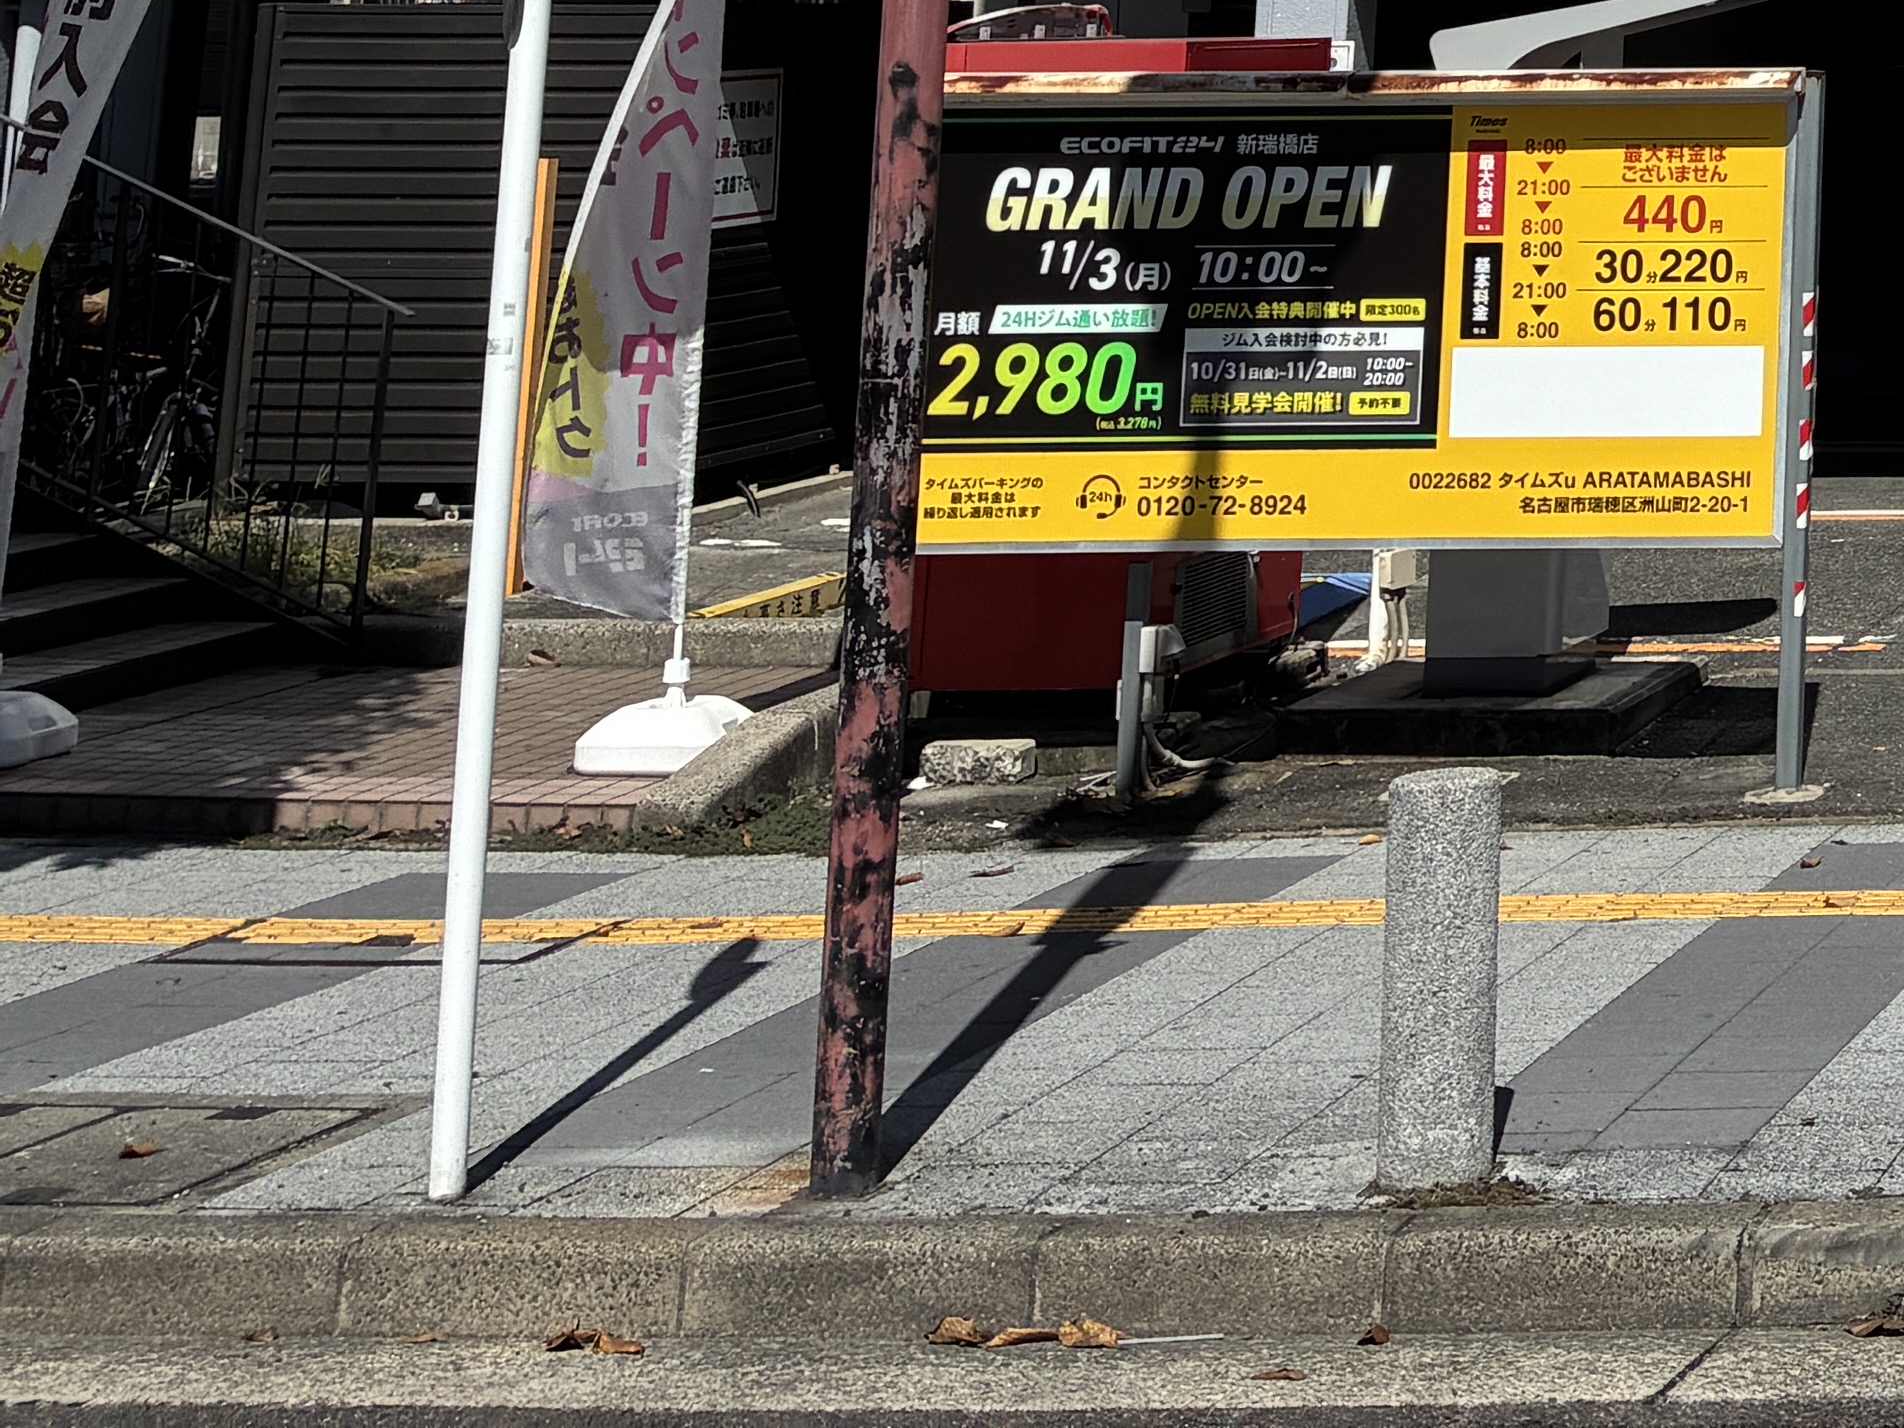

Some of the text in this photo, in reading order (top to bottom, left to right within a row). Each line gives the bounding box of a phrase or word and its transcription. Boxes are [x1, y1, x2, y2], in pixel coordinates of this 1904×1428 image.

[1469, 115, 1508, 128] Times
[1059, 133, 1320, 155] ECOFIT24 新瑞橋店
[1524, 138, 1567, 155] 8:00
[1622, 145, 1727, 164] 最大料金は
[1621, 164, 1728, 183] ございません
[1516, 179, 1571, 197] 21:00
[985, 164, 1394, 232] GRAND OPEN
[1622, 194, 1723, 234] 440円
[1520, 218, 1563, 235] 8:00
[1520, 241, 1562, 258] 8:00
[1512, 282, 1567, 300] 21:00
[934, 311, 980, 336] 月額
[1516, 321, 1559, 339] 8:00
[926, 342, 1164, 421] 2,980円
[1363, 372, 1405, 387] 20:00
[1138, 475, 1264, 490] コンタクトセンター
[1409, 472, 1492, 490] 0022682
[1582, 471, 1752, 488] ARATAMABASHI
[950, 491, 1016, 505] 最大料金は
[1088, 490, 1113, 503] 24h
[1136, 494, 1308, 517] 0120-72-8924
[1518, 495, 1749, 515] 名古屋市瑞穂区洲山町2-20-1
